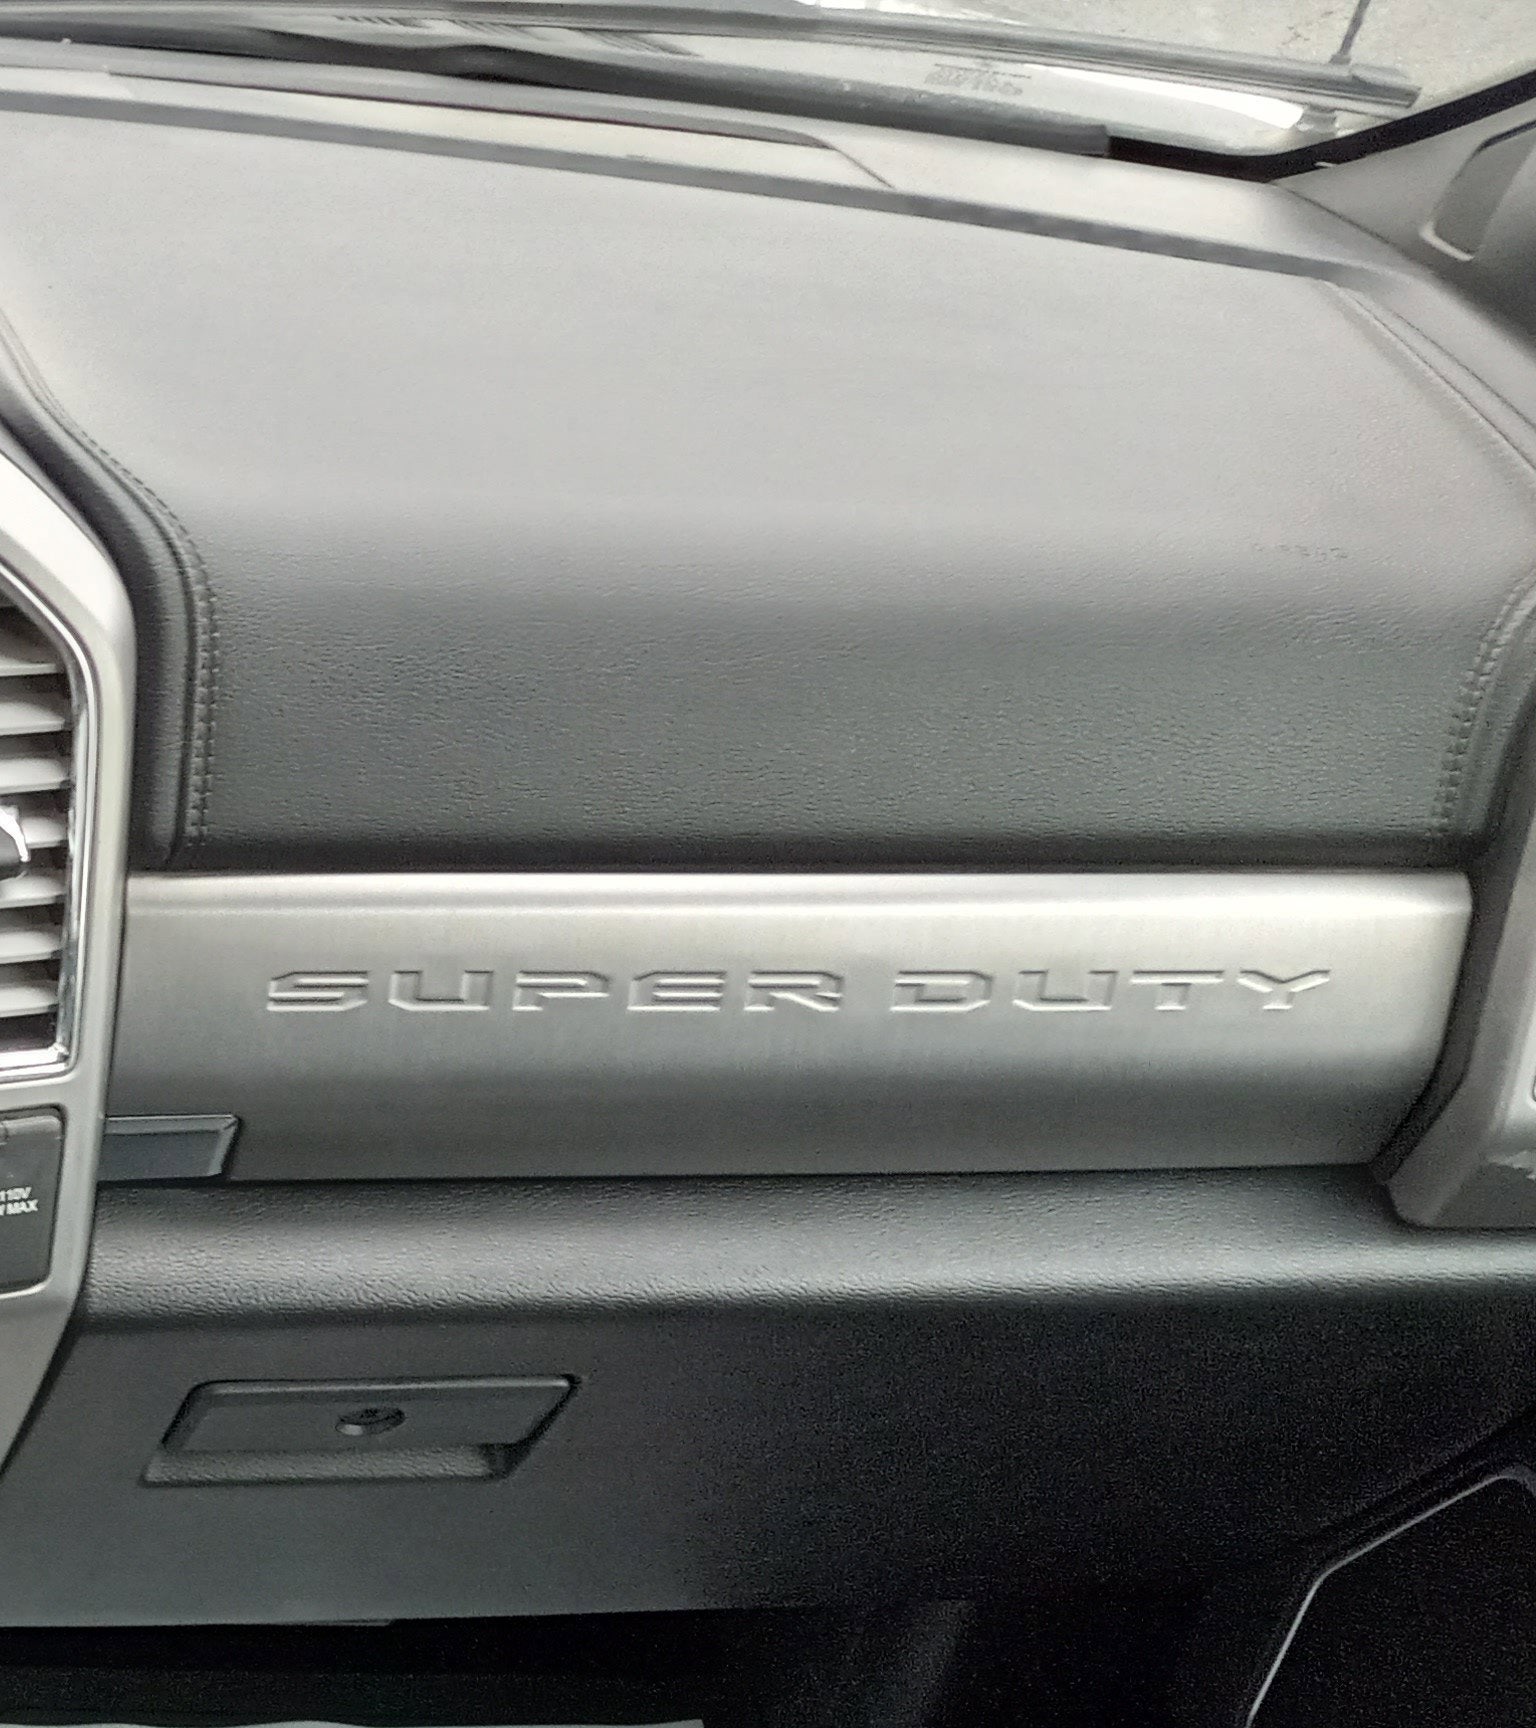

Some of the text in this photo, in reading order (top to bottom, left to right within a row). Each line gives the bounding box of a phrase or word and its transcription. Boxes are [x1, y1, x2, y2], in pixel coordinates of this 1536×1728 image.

[266, 968, 1331, 1013] SUPER DUTY
[6, 1199, 38, 1215] MAX
